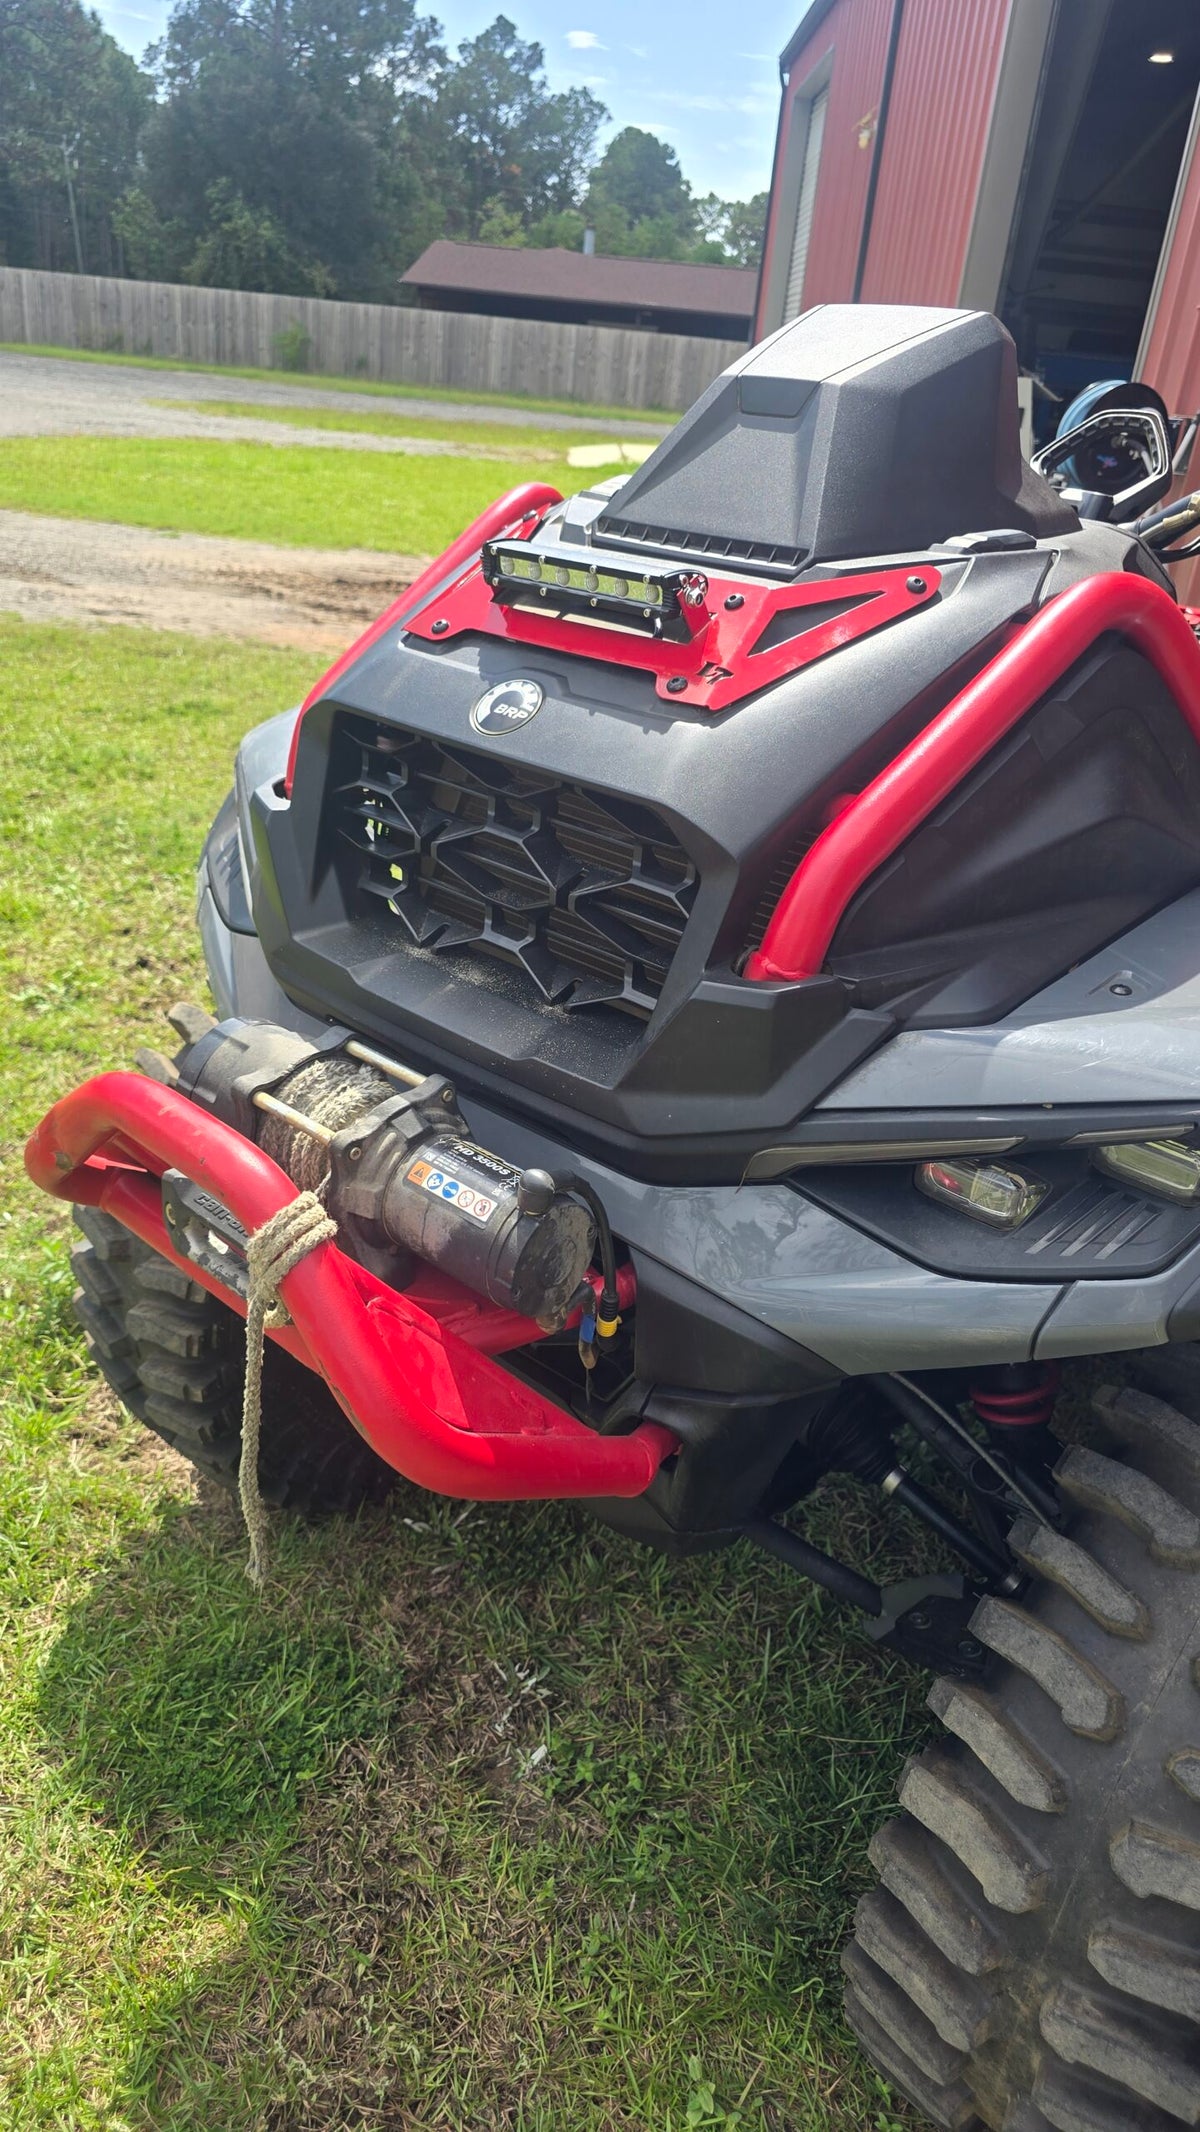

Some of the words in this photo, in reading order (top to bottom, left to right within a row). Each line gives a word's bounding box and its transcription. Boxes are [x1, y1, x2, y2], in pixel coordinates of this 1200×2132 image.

[494, 703, 529, 720] BRP
[454, 1144, 475, 1156] HD
[473, 1154, 511, 1176] 3500S
[193, 1192, 249, 1238] can-a
